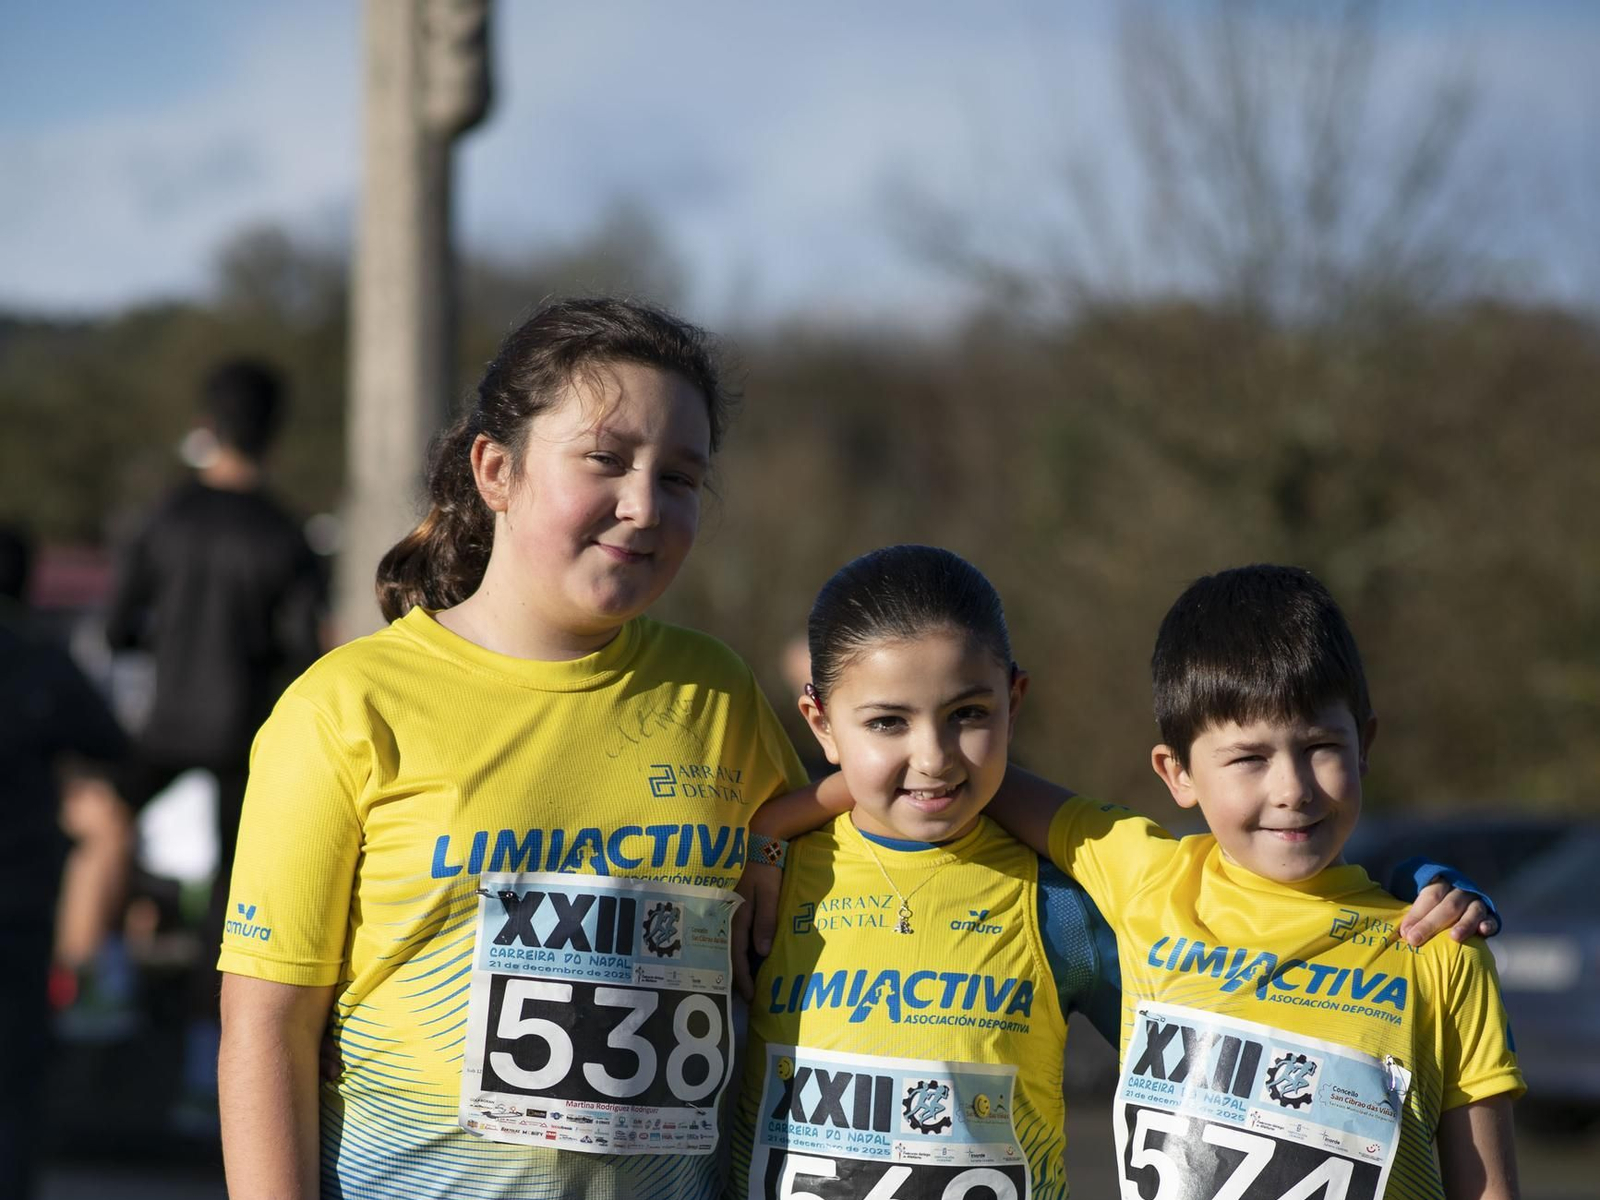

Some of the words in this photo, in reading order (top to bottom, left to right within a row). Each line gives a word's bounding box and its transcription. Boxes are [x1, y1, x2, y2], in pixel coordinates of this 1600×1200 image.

[678, 765, 745, 784] ARRANZ
[683, 784, 749, 805] DENTAL
[431, 824, 747, 878] LIMIACTIVA
[820, 894, 894, 912] ARRANZ
[492, 890, 637, 956] XXII
[815, 913, 891, 931] DENTAL
[950, 920, 1003, 935] amura
[489, 947, 556, 963] CARREIRA
[564, 953, 582, 965] DO
[589, 956, 632, 970] NADAL
[489, 960, 500, 968] 21
[504, 961, 519, 969] de
[522, 962, 584, 976] decembro
[603, 970, 632, 980] 2025
[769, 969, 1034, 1024] LIMIACTIVA
[1268, 993, 1340, 1011] ASOCIACIÓN
[1341, 1004, 1403, 1026] DEPORTIVA
[903, 1014, 976, 1028] ASOCIACIÓN
[978, 1017, 1030, 1035] DEPORTIVA
[488, 978, 725, 1104] 538
[1128, 1077, 1175, 1094] CARREIRA
[1332, 1085, 1359, 1098] Concello
[565, 1100, 595, 1109] Martina
[771, 1066, 894, 1133] XXII
[1330, 1093, 1344, 1102] San
[1344, 1096, 1366, 1109] Cibrao
[1366, 1104, 1379, 1112] das
[1216, 1109, 1245, 1122] 2025
[768, 1121, 818, 1138] CARREIRA
[826, 1129, 840, 1140] DO
[847, 1132, 890, 1146] NADAL
[846, 1144, 860, 1153] de
[862, 1147, 891, 1156] 2025
